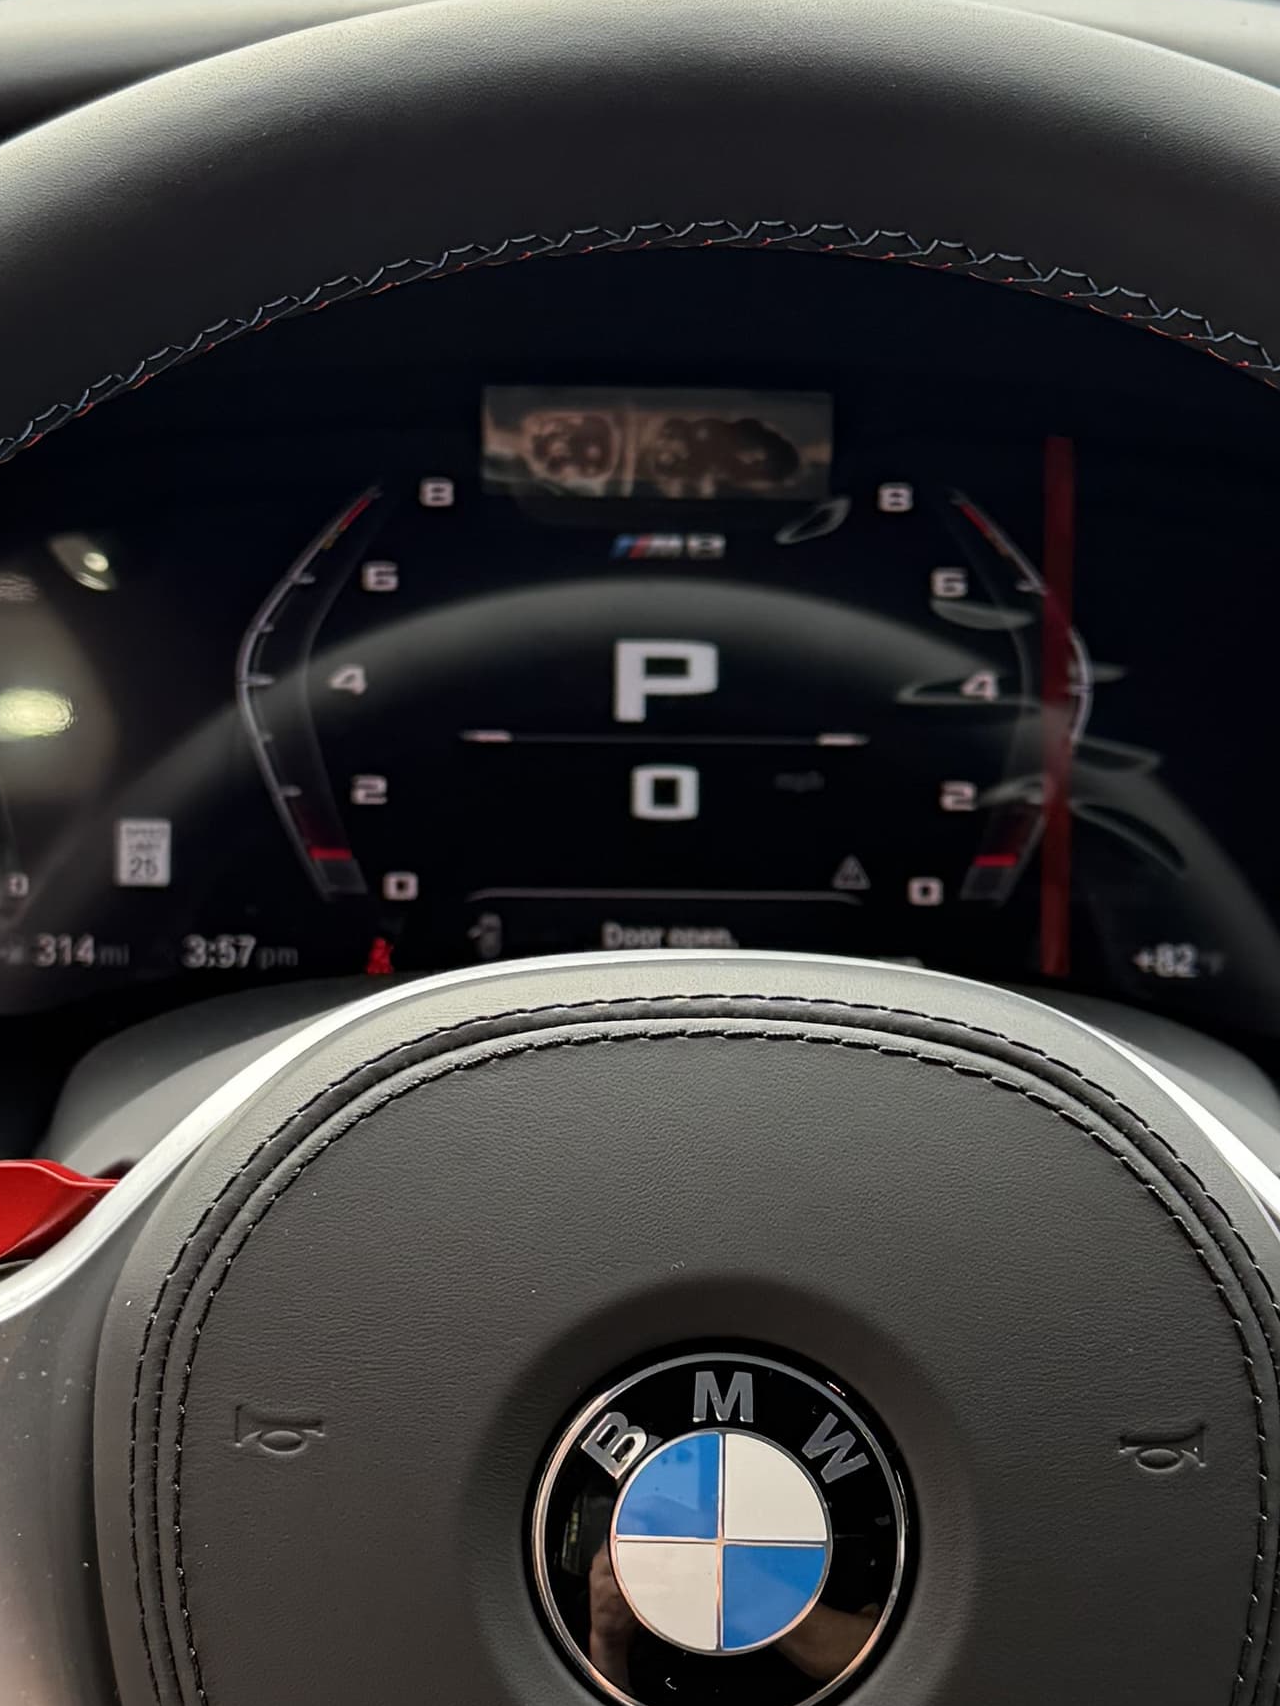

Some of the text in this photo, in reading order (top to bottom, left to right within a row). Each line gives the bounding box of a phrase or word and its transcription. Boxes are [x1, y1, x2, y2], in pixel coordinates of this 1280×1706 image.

[420, 478, 454, 507] 8
[878, 483, 913, 512] 8
[362, 561, 399, 592] 6
[932, 567, 968, 597] 6
[328, 662, 368, 695] 4
[615, 639, 718, 723] P
[961, 670, 999, 702] 4
[350, 775, 388, 805] 2
[631, 764, 700, 820] 0
[940, 781, 977, 812] 2
[384, 871, 419, 901] 0
[908, 877, 944, 907] 0
[34, 934, 96, 968] 314
[183, 933, 257, 969] 3:57
[580, 1369, 870, 1483] BMW
